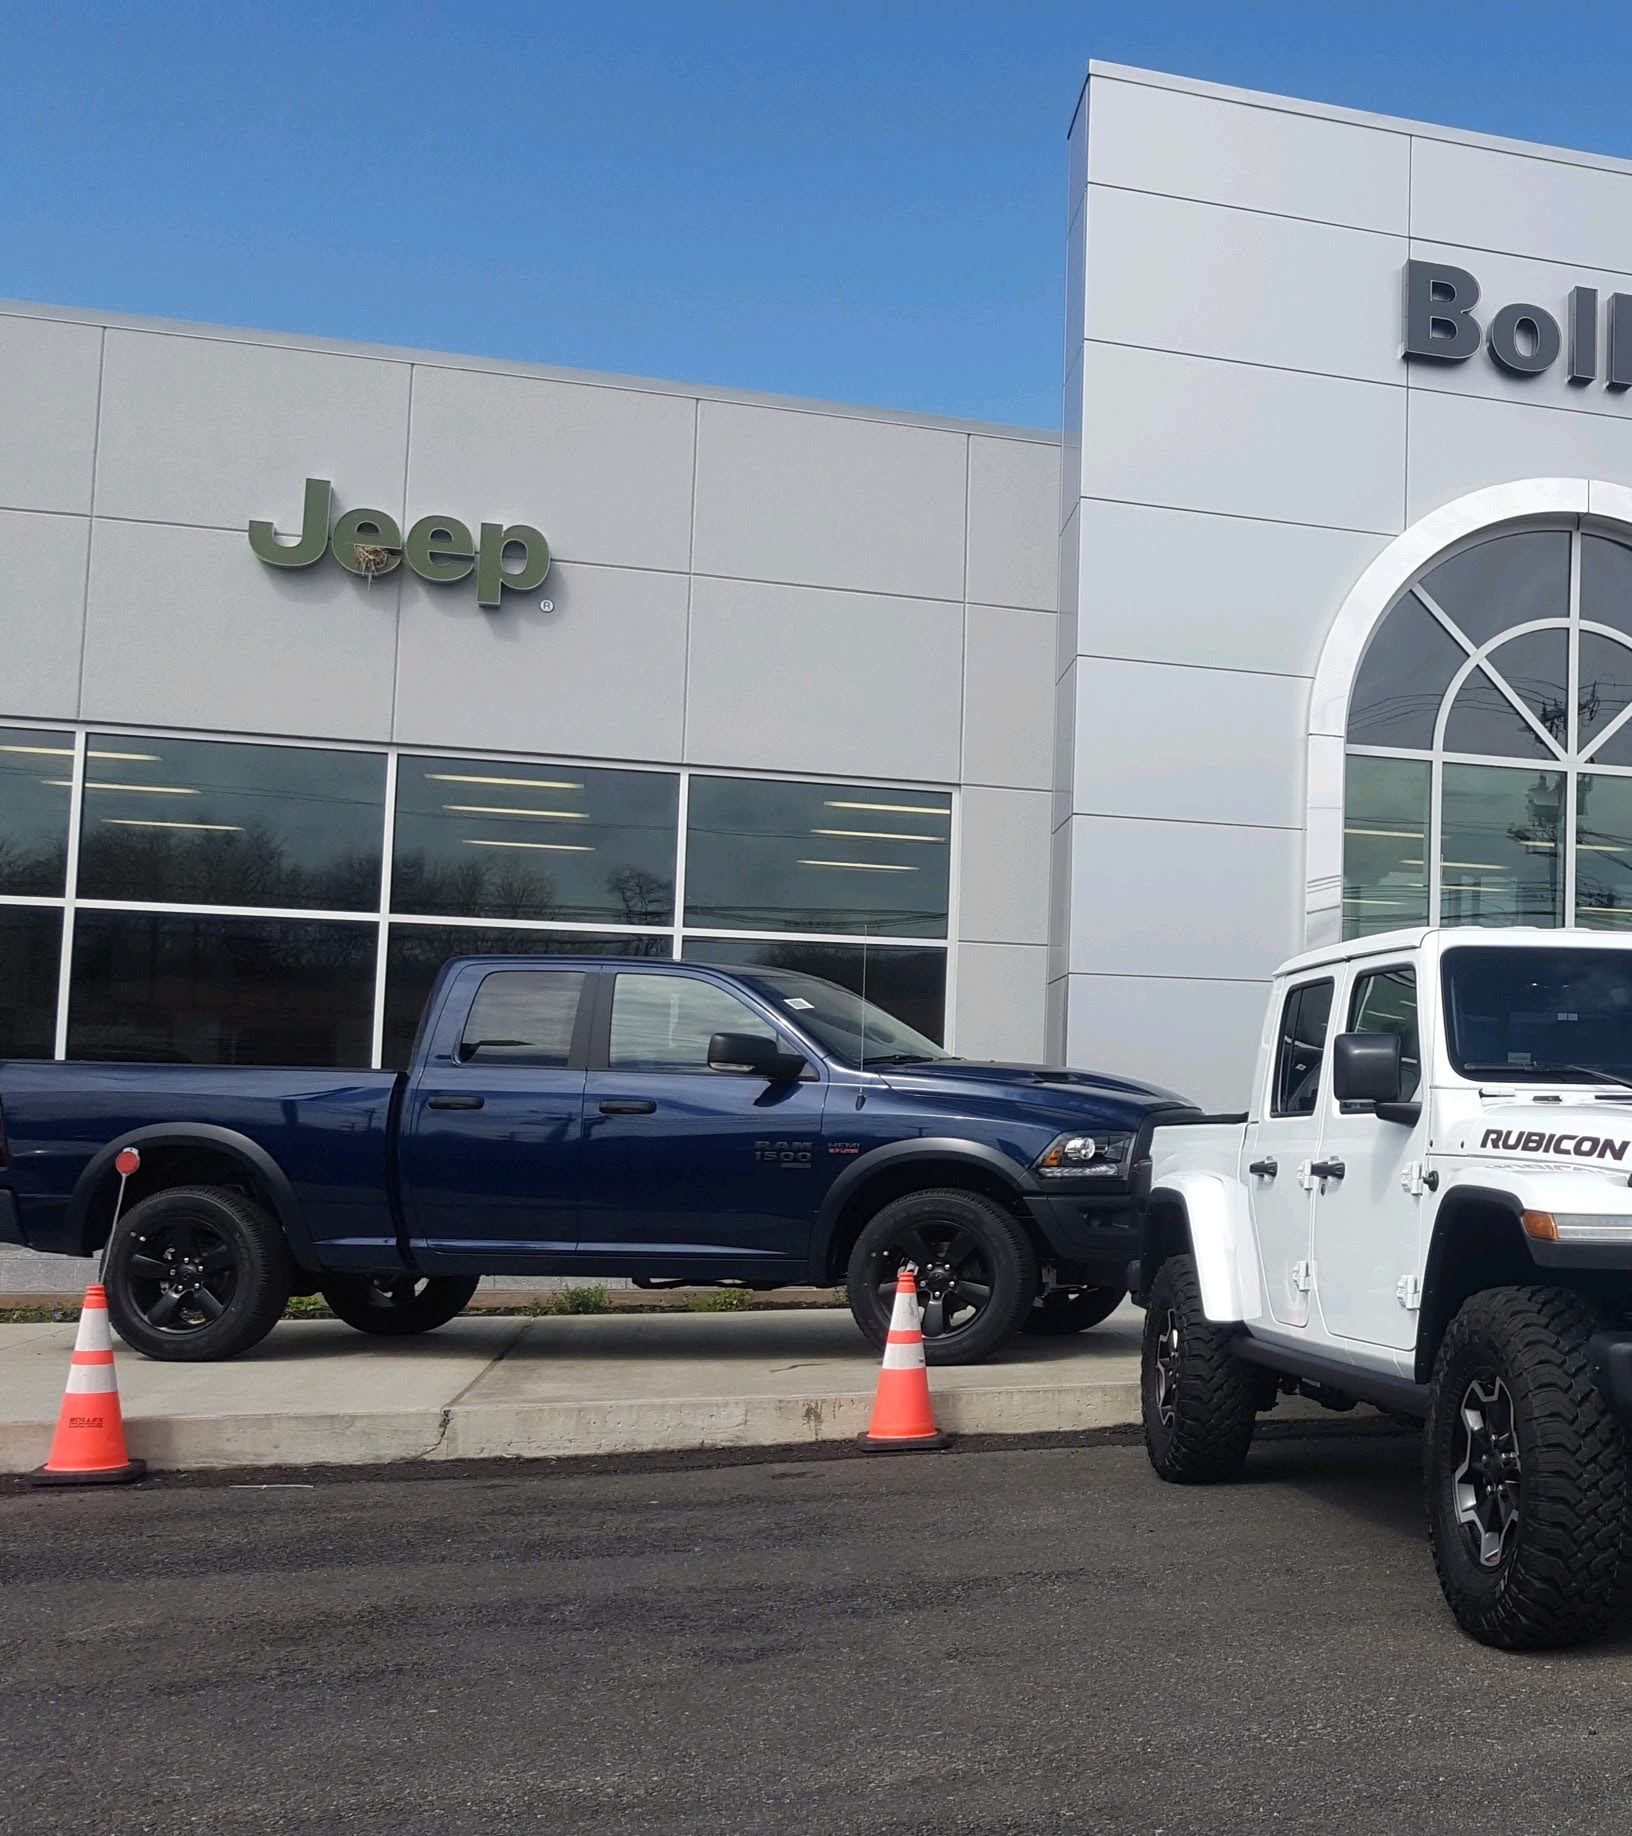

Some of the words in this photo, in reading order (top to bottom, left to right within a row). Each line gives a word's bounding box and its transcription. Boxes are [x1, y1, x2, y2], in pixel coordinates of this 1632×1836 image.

[247, 477, 551, 608] Jeep
[754, 1140, 814, 1151] RAM
[1480, 1128, 1632, 1161] RUBICON
[754, 1151, 812, 1162] 1500
